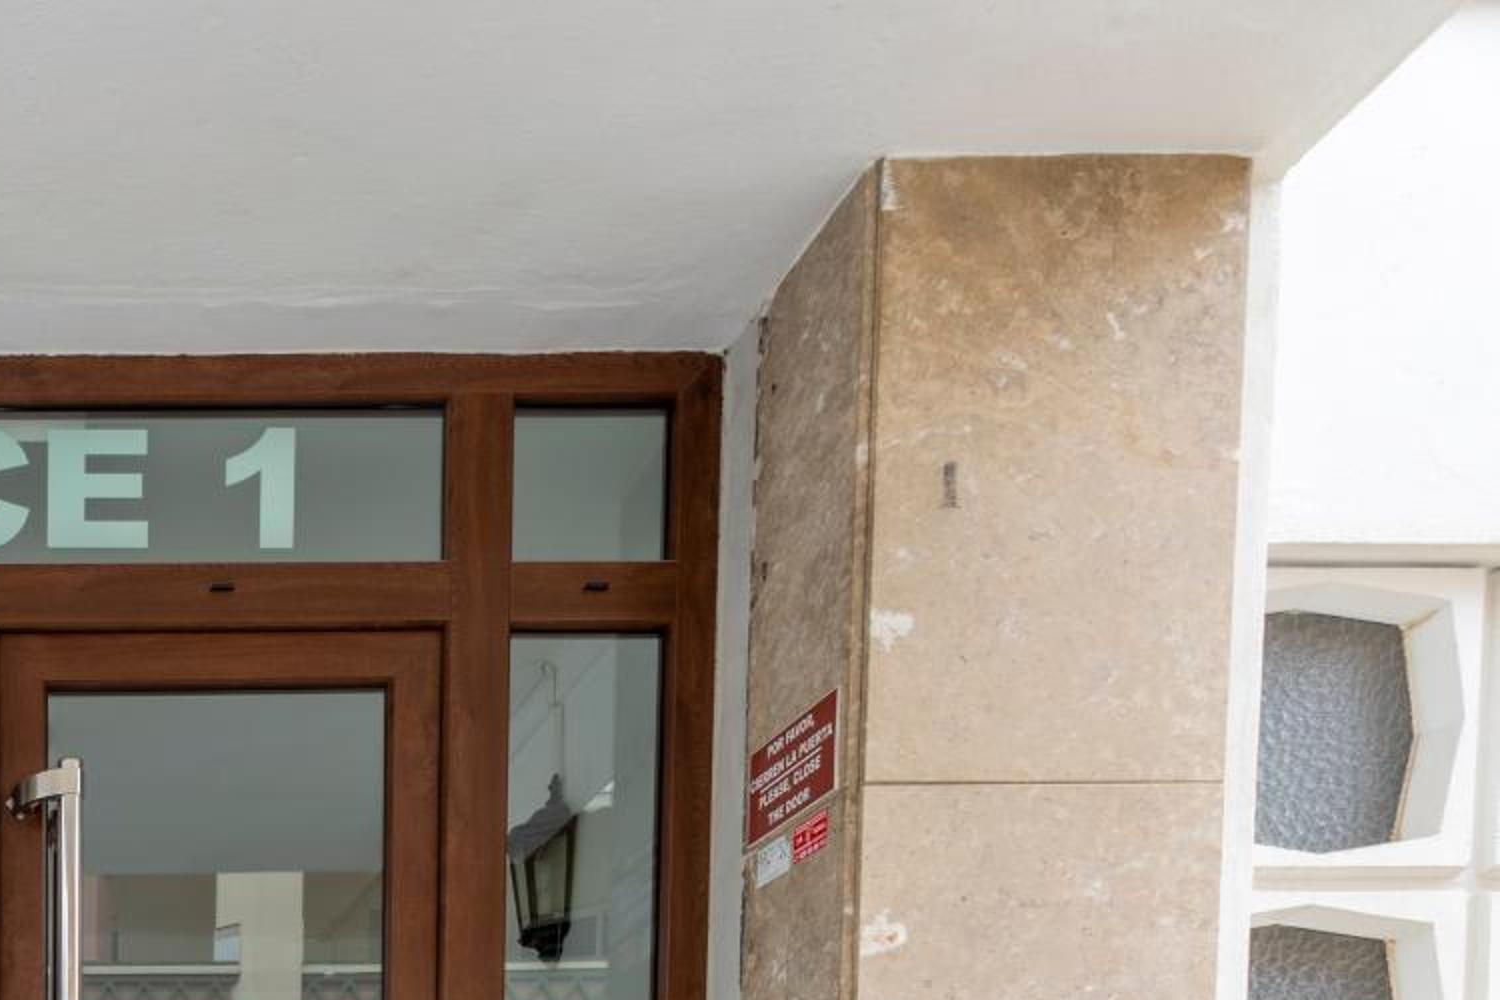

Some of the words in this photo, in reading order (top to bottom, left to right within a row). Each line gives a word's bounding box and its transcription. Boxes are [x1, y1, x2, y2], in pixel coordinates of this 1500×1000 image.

[225, 427, 296, 549] 1
[786, 749, 797, 769] LA
[793, 754, 821, 785] CLOSE
[768, 803, 785, 825] THE
[786, 786, 810, 814] DOOR
